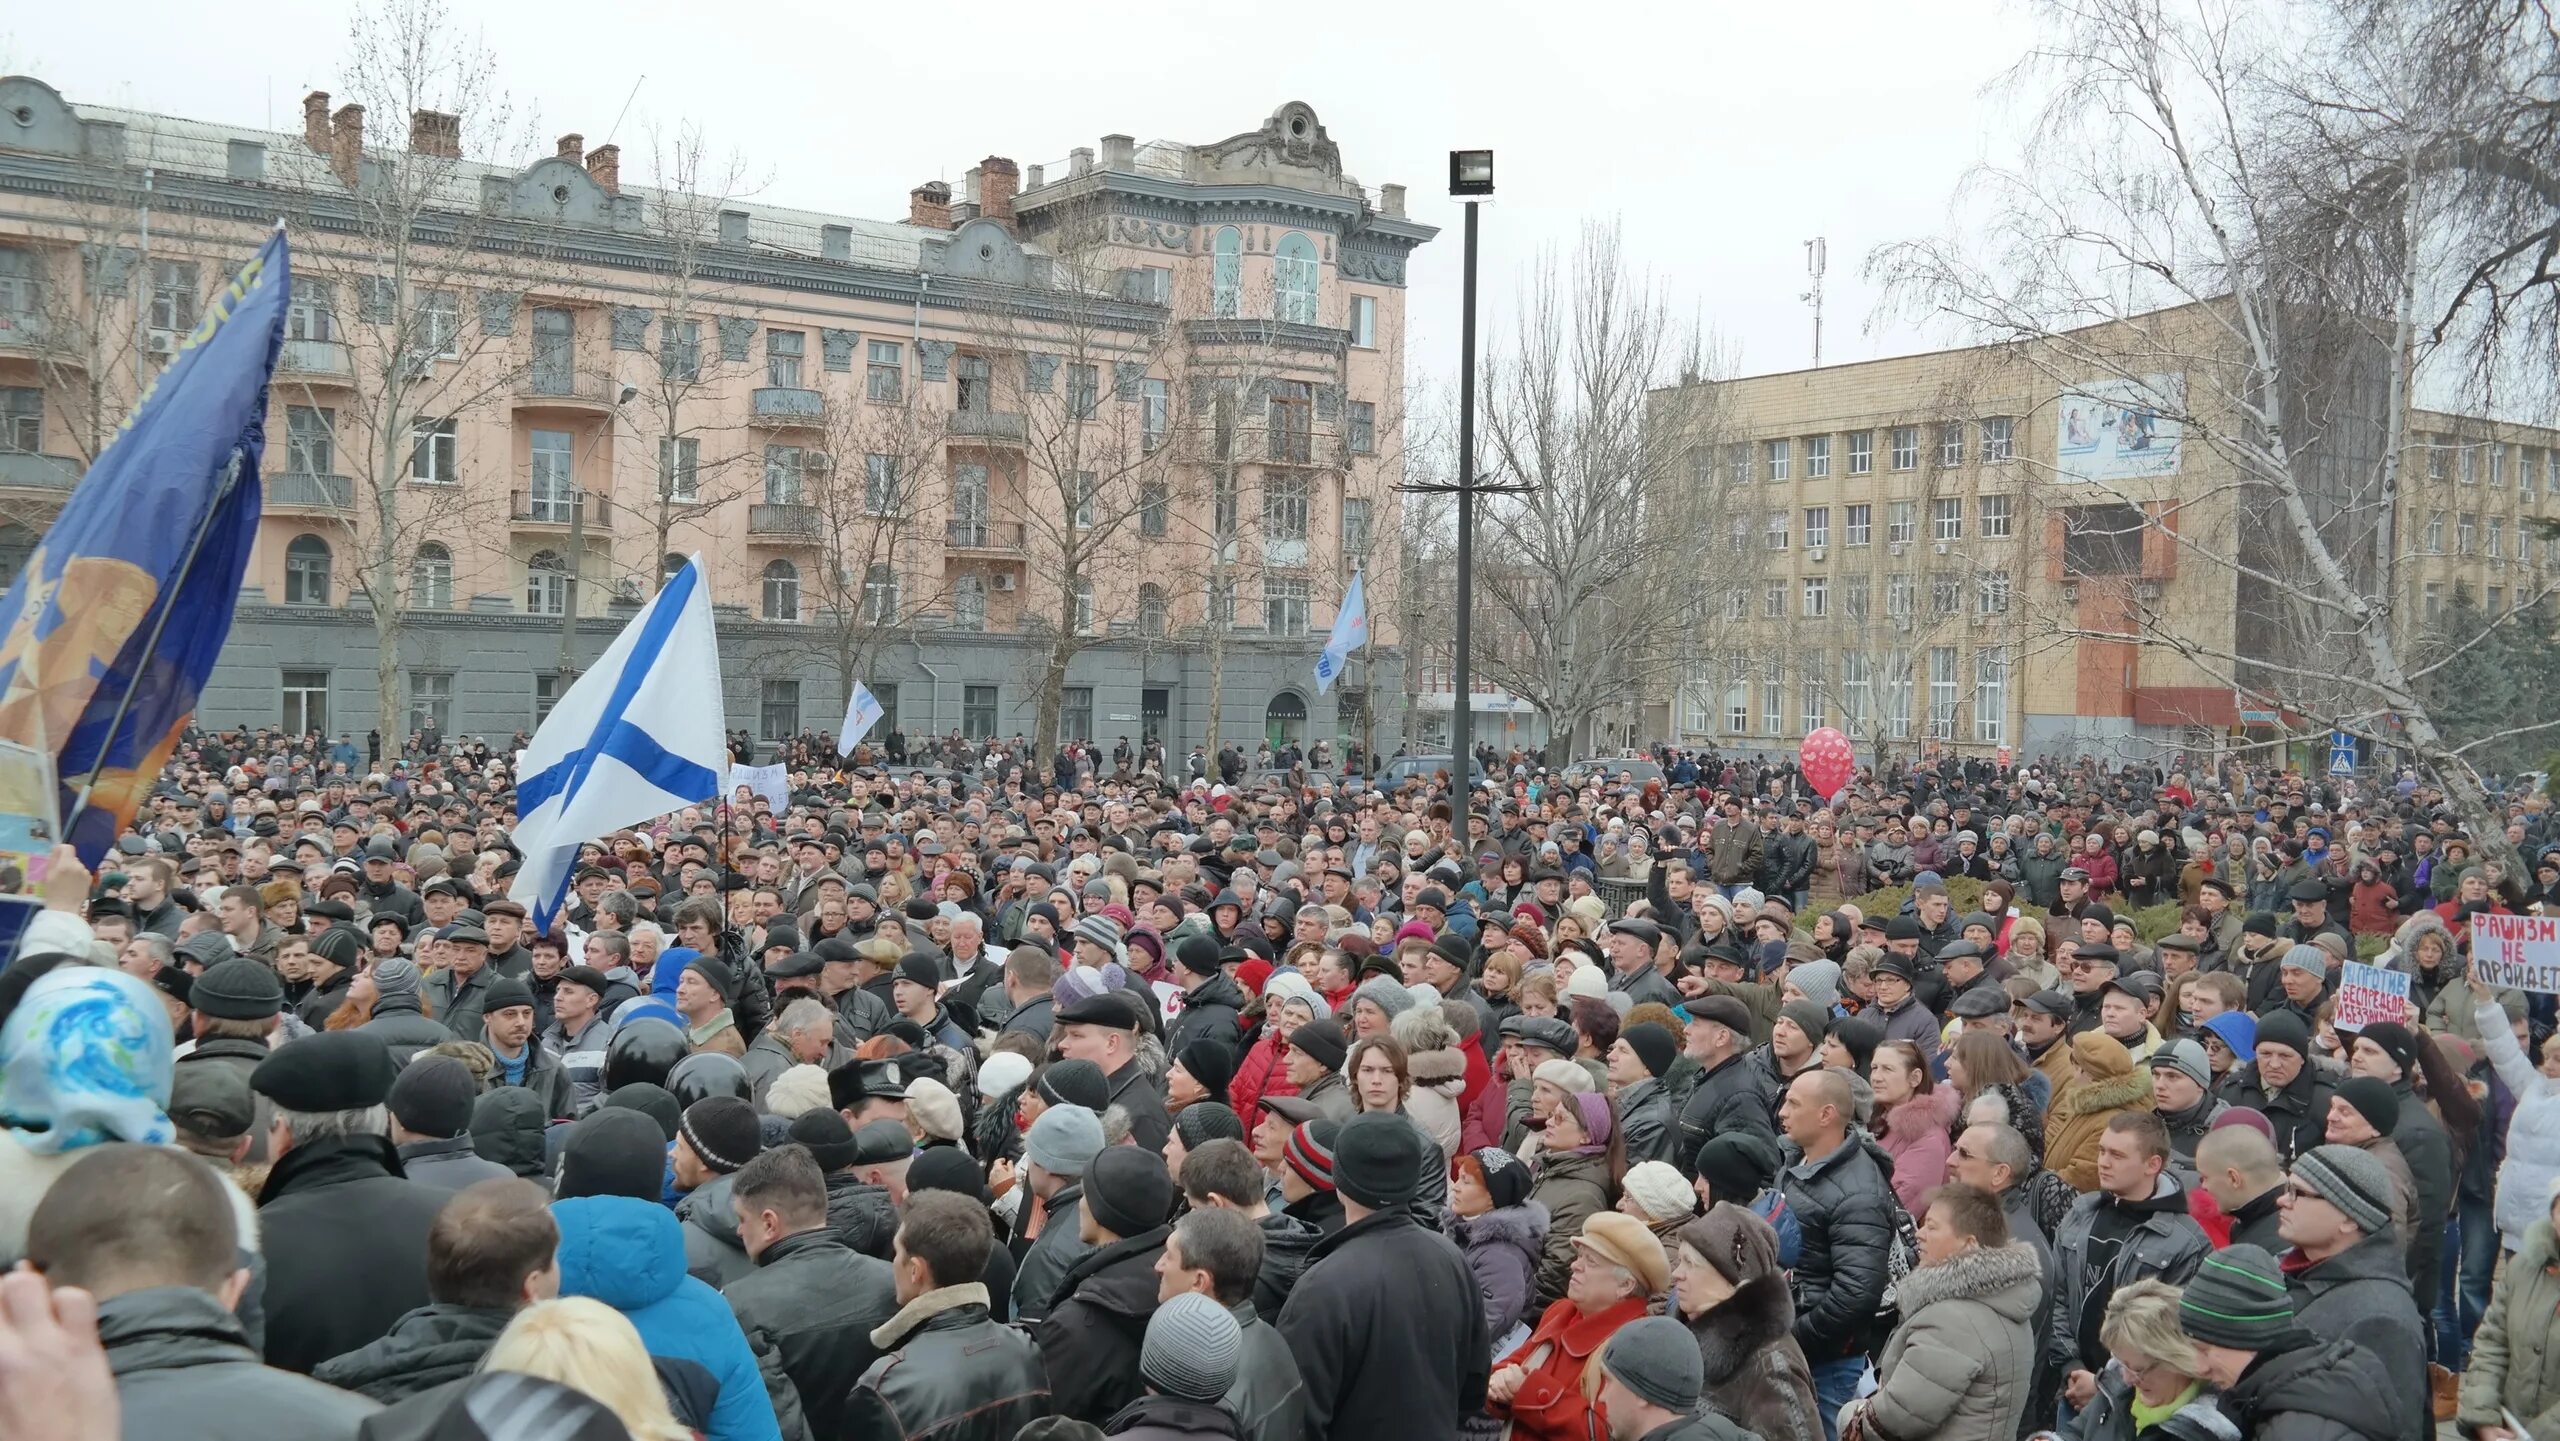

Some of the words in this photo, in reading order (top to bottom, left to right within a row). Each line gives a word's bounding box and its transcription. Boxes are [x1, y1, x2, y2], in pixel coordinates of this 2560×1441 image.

[2474, 914, 2556, 942] ФАШИЗМ
[2502, 941, 2526, 963] НЕ
[2358, 965, 2406, 995] ПРОТИВ
[2342, 983, 2405, 1013] БЕСПРЕДЕЛА
